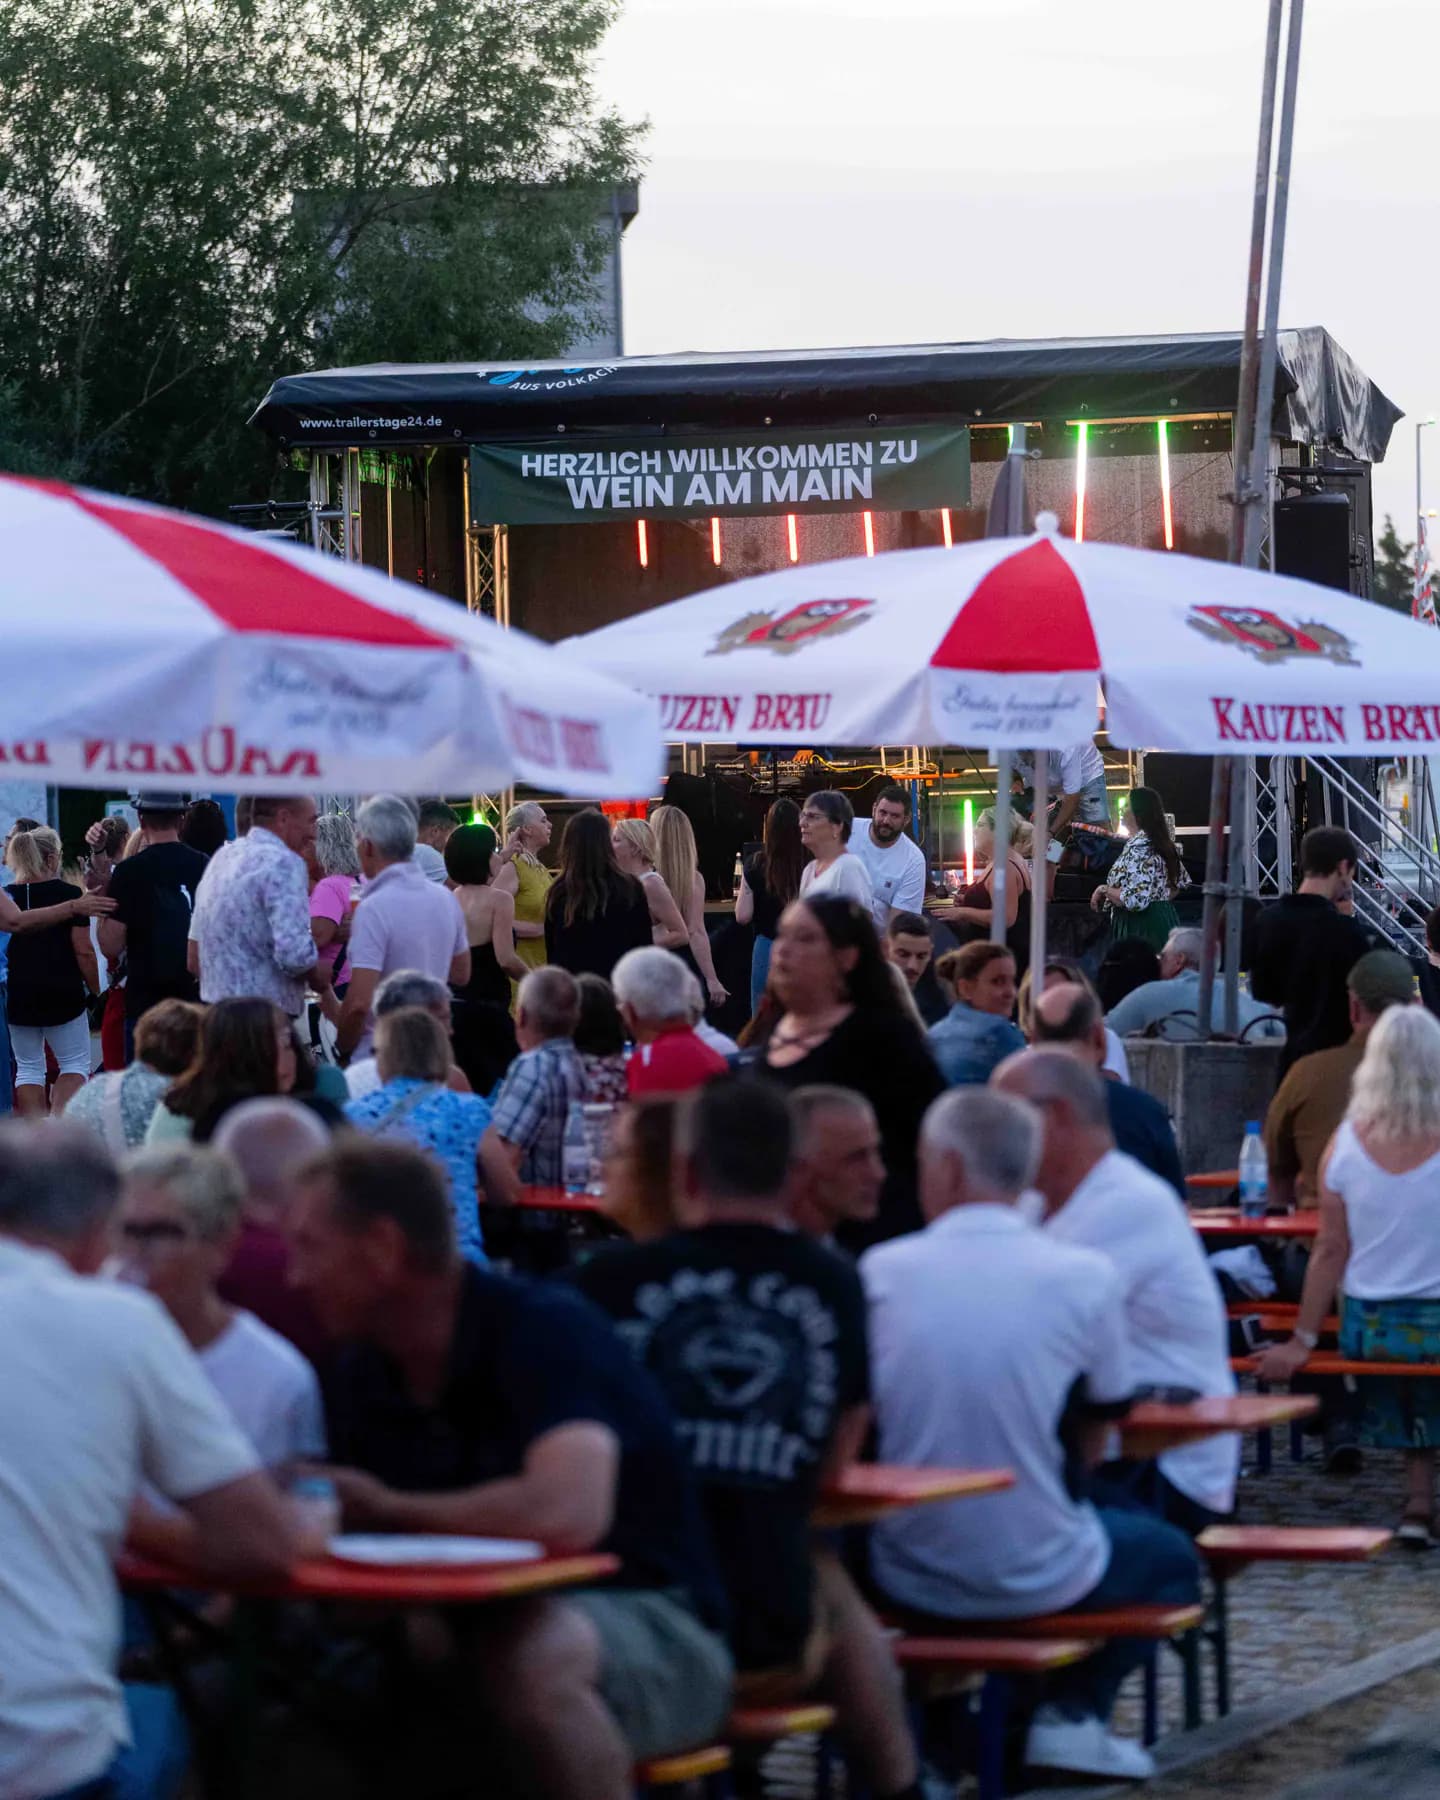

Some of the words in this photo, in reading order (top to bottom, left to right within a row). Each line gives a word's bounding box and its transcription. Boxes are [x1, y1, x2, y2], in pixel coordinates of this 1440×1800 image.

[508, 381, 540, 391] AUS
[299, 416, 443, 430] www.trailerstage24.de
[521, 450, 662, 477] HERZLICH
[667, 441, 873, 473] WILLKOMMEN
[879, 439, 918, 464] ZU
[565, 474, 674, 510] WEIN
[683, 471, 752, 506] AM
[761, 466, 873, 503] MAIN
[658, 693, 742, 732] UZEN
[1210, 697, 1347, 743] KAUZEN
